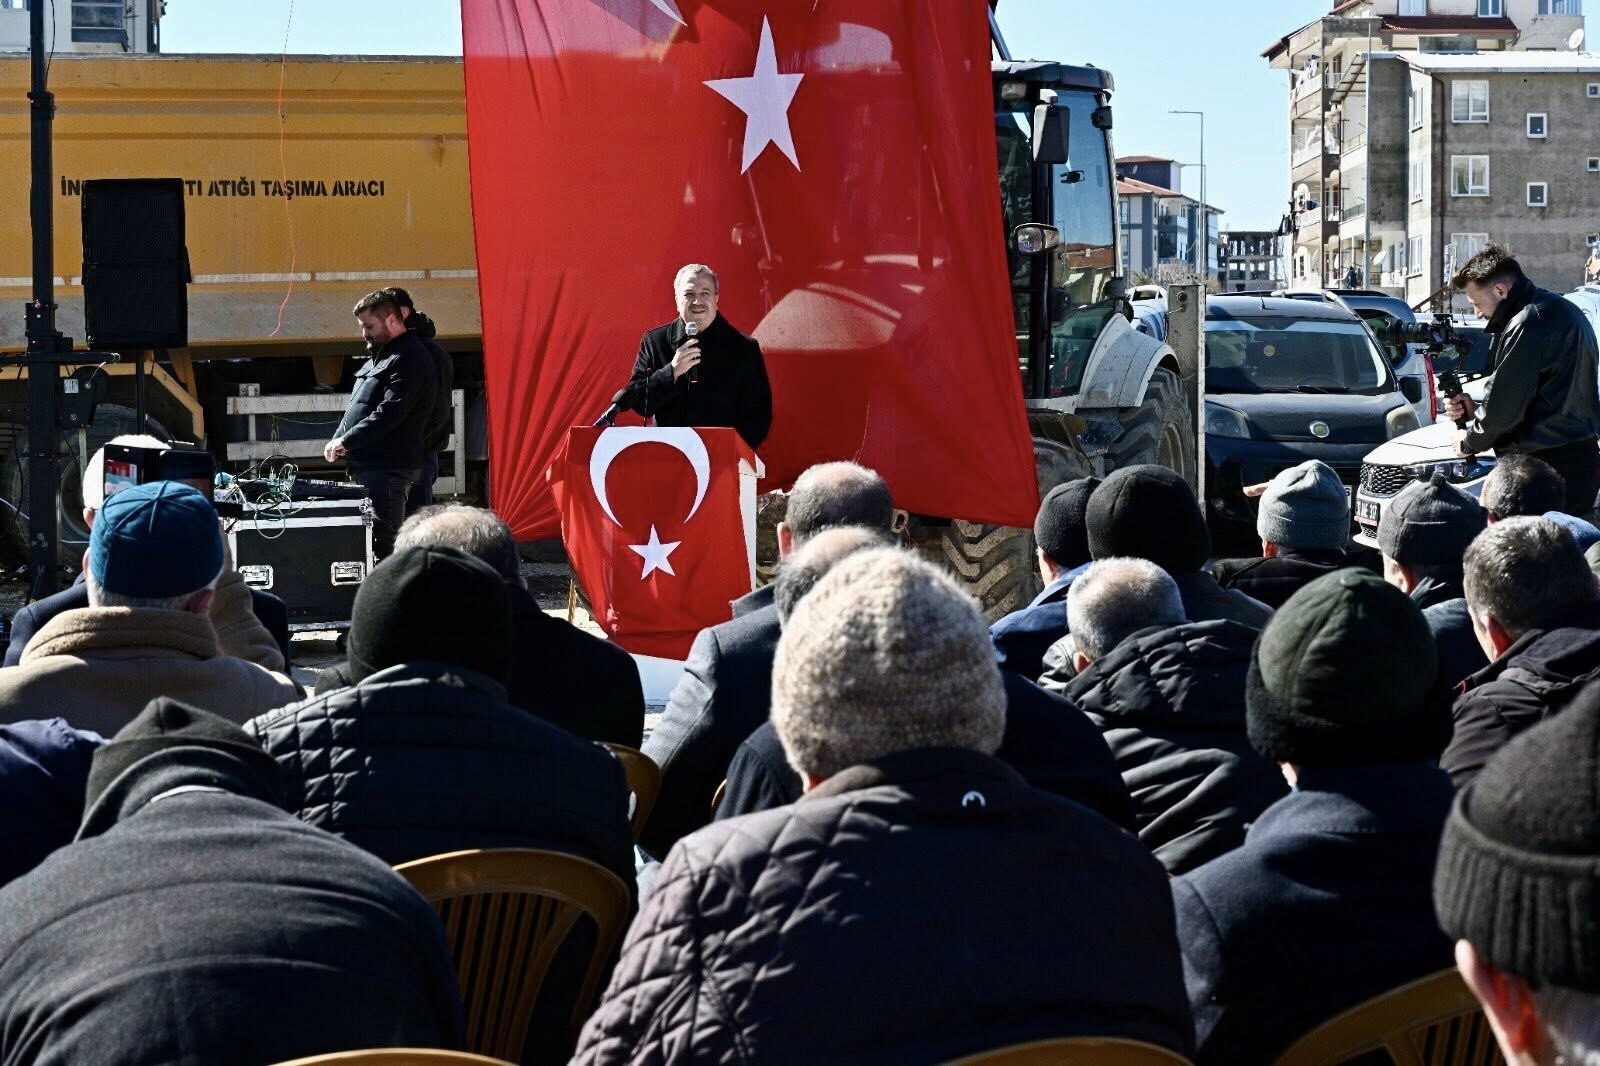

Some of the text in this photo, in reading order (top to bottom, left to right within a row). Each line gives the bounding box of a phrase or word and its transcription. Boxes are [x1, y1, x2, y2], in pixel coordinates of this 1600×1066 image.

[61, 176, 385, 200] İN TI ATIĞI TAŞIMA ARACI
